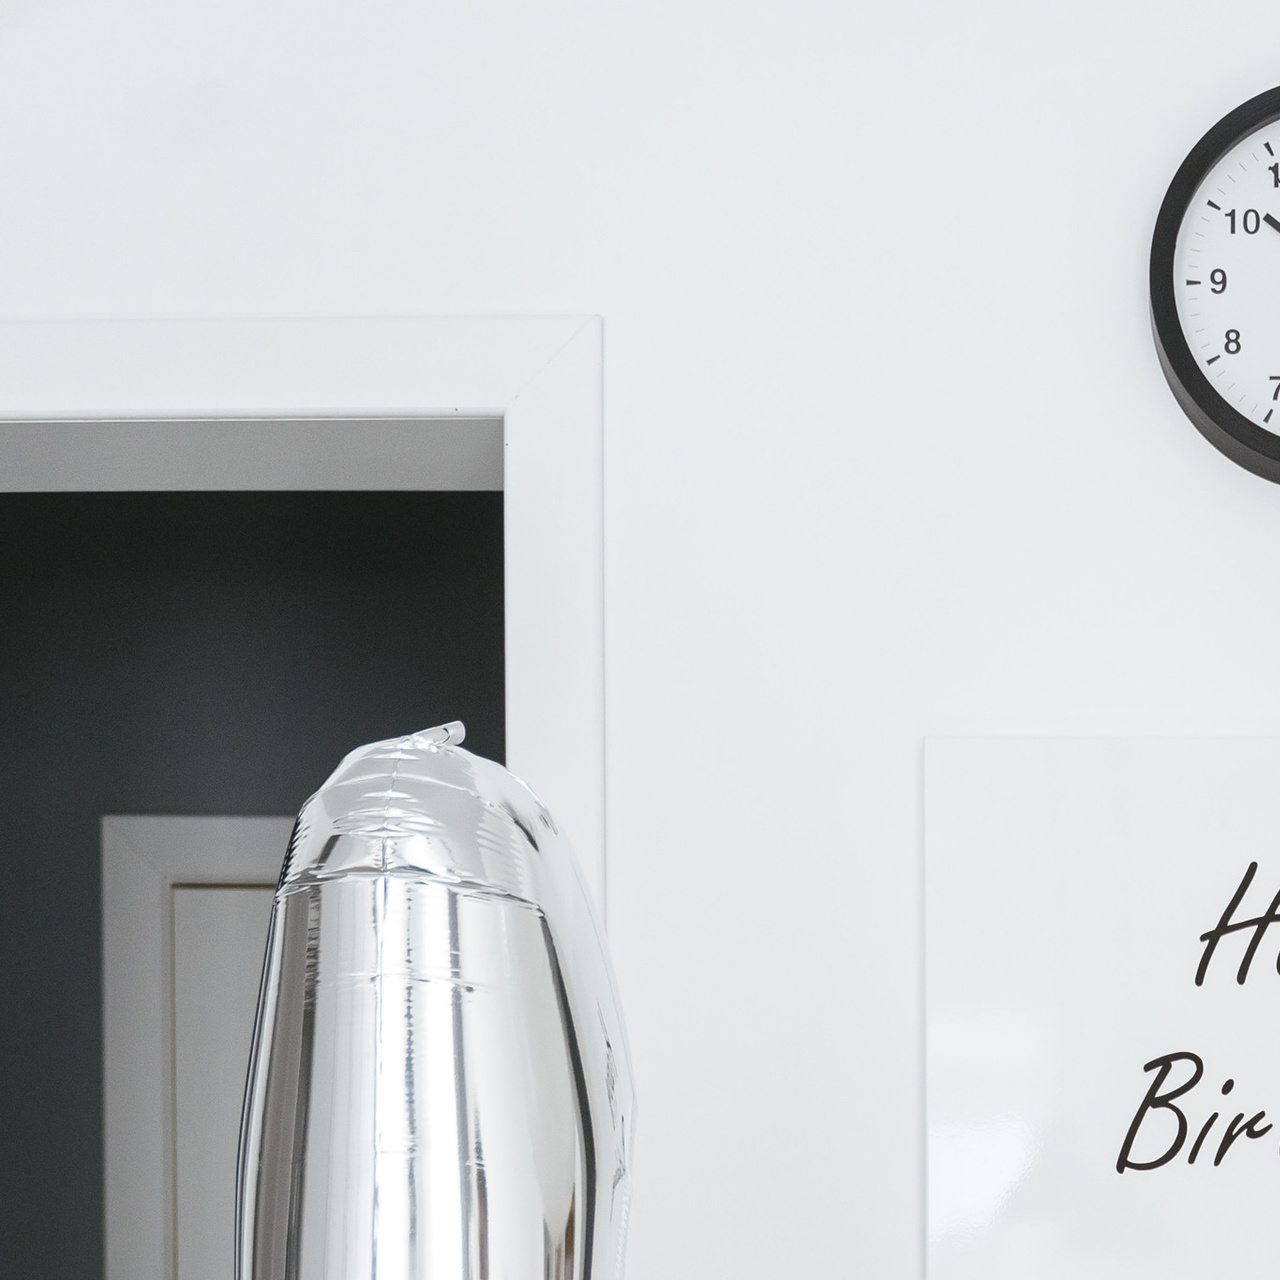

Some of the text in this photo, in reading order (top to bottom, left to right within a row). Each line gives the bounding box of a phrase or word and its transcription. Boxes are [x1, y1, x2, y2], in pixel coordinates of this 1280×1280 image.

[1224, 208, 1261, 235] 10
[1209, 268, 1228, 294] 9
[1223, 328, 1242, 355] 8
